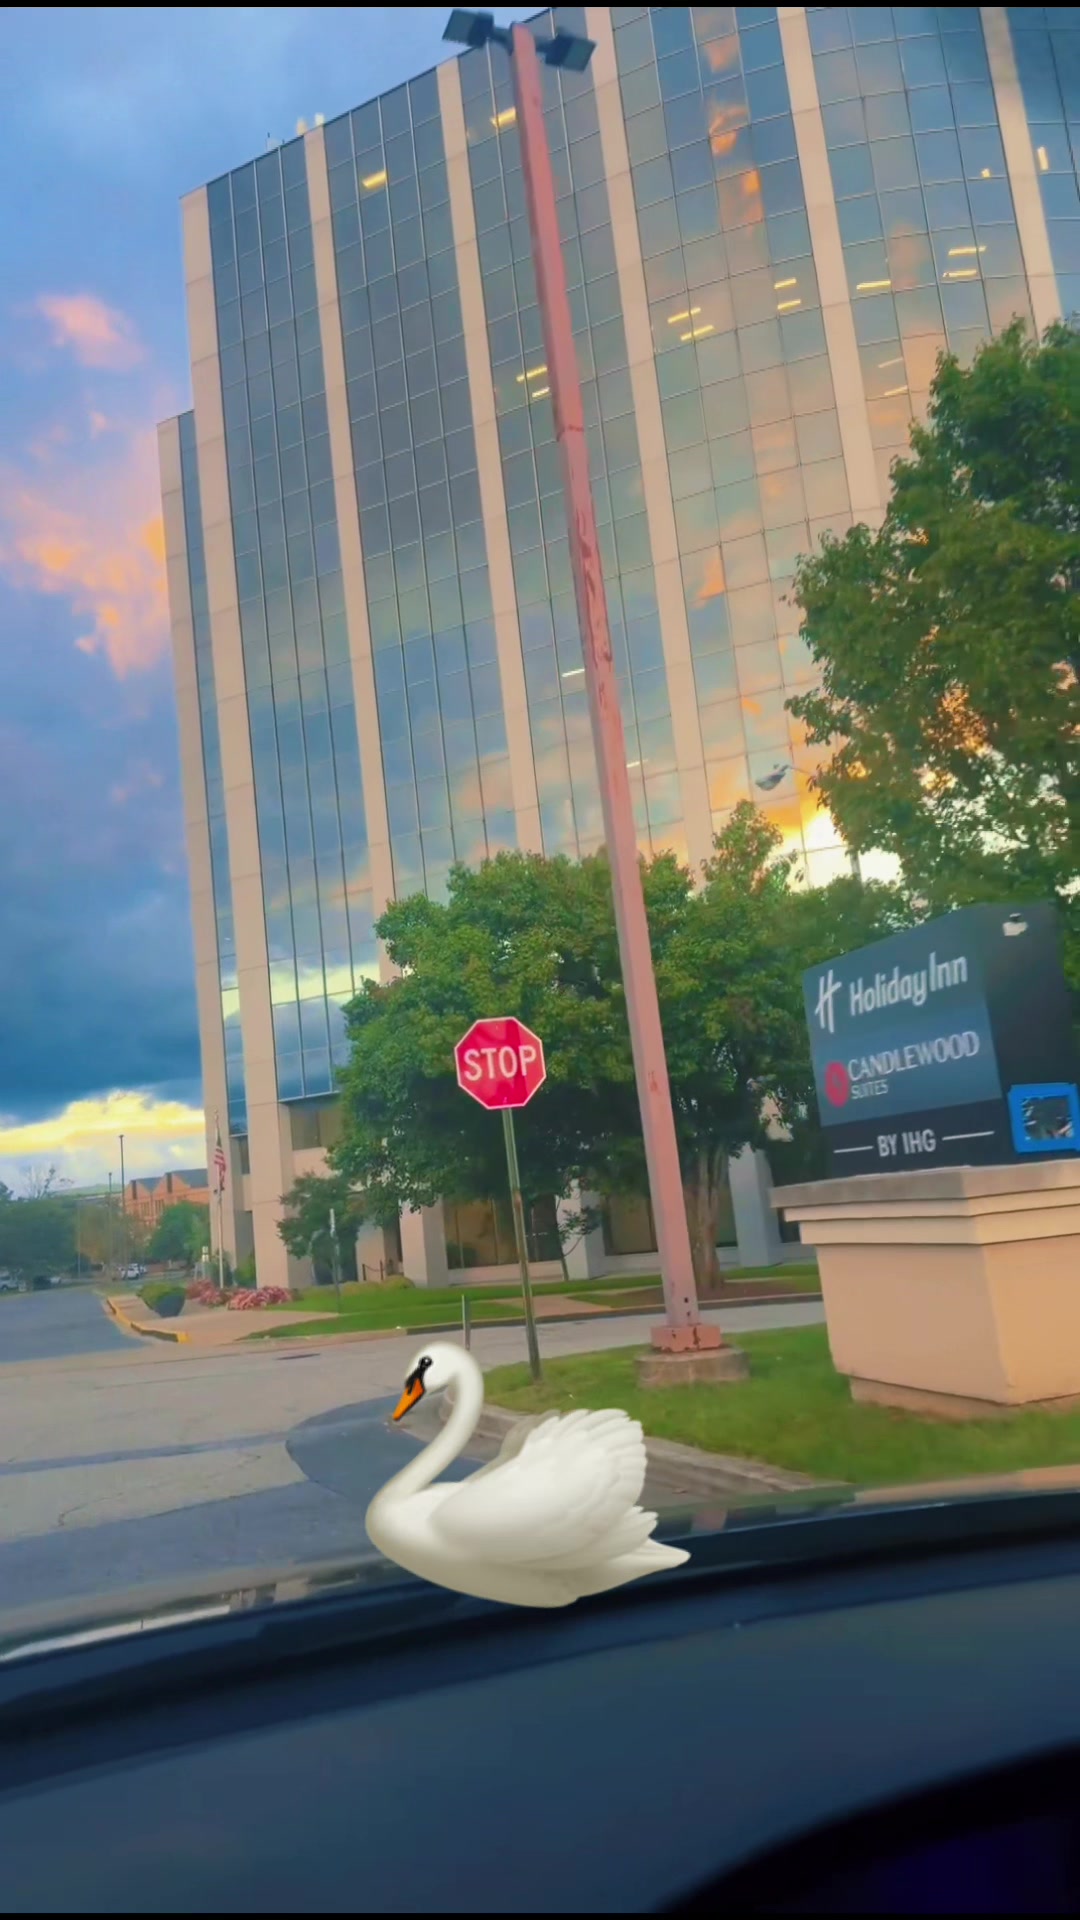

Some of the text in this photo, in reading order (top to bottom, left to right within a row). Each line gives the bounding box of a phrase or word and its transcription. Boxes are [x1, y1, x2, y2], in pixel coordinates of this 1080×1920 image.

[850, 951, 968, 1016] Holiday Inn
[463, 1045, 537, 1081] STOP
[848, 1031, 980, 1081] CANDLEWOOD
[851, 1079, 888, 1099] SUITES
[877, 1129, 936, 1157] BY IHG
